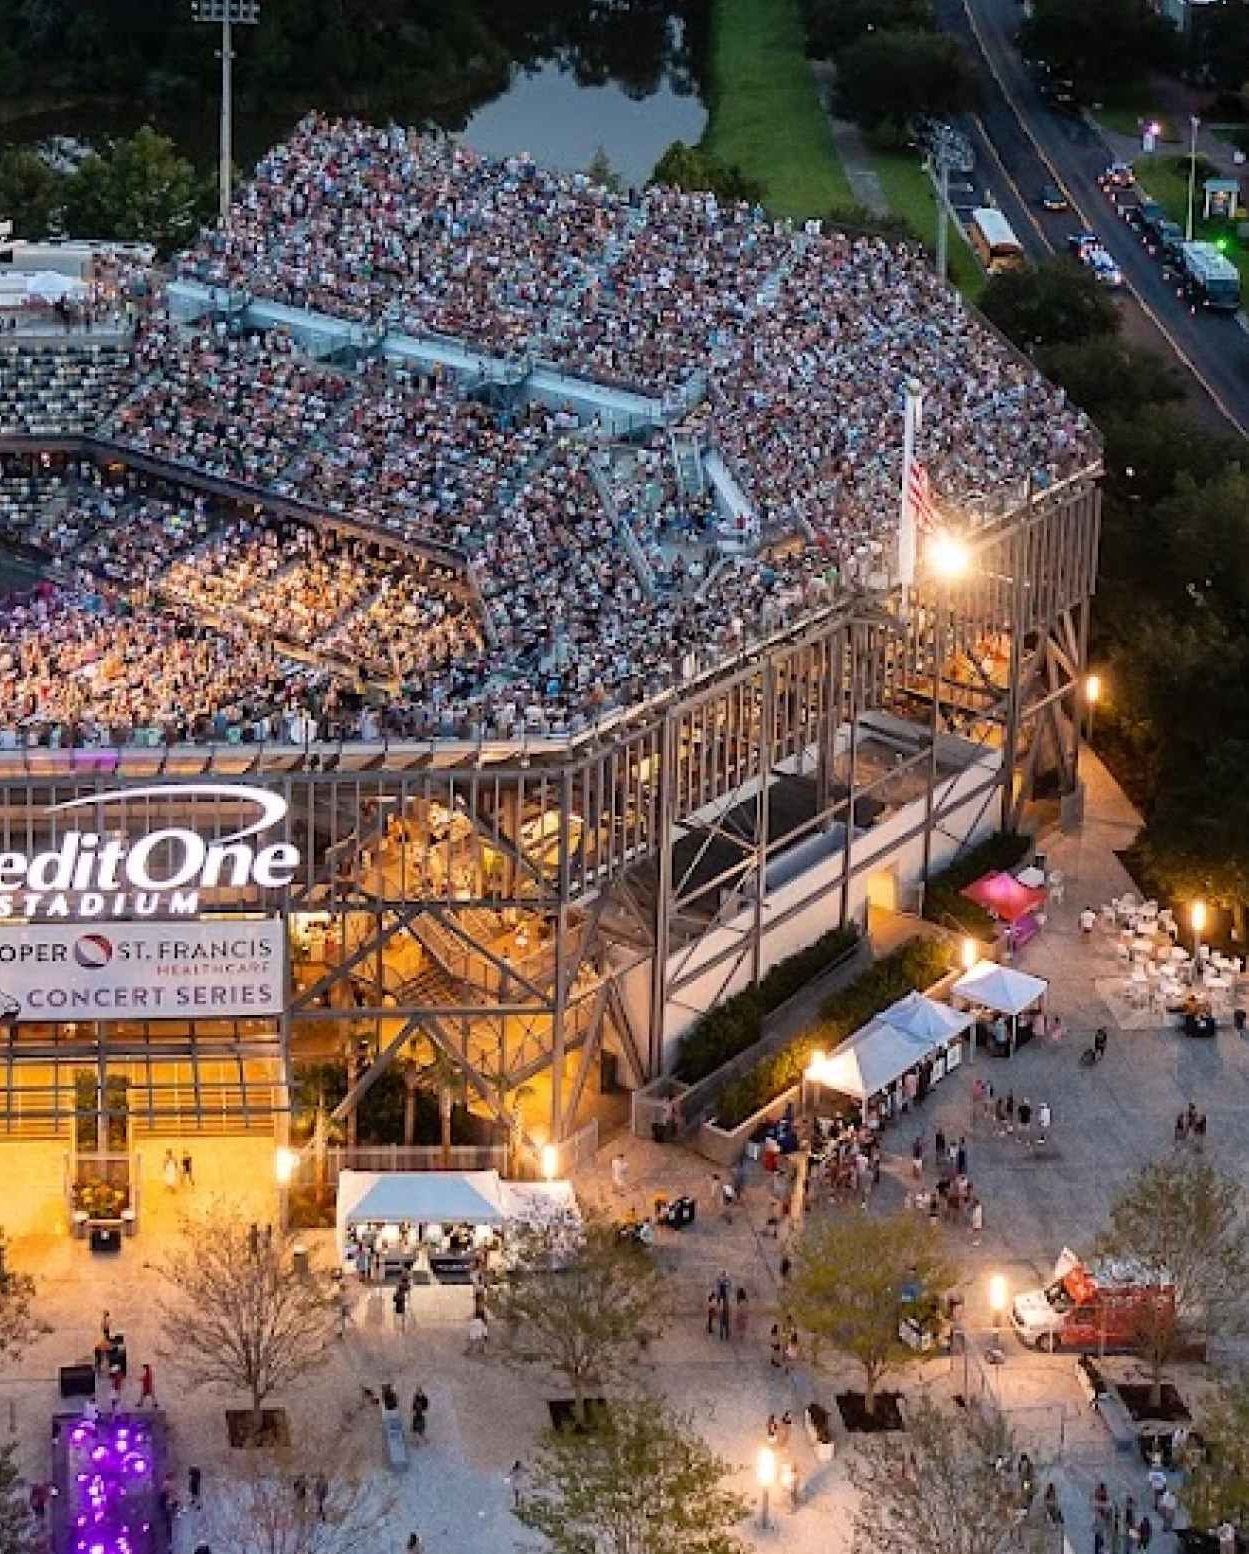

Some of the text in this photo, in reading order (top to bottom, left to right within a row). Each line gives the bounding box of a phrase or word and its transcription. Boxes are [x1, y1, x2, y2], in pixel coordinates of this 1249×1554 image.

[117, 940, 153, 962] ST.
[157, 937, 273, 960] FRANCIS
[156, 960, 270, 977] HEALTHCARE
[26, 983, 273, 1008] CONCERT SERIES
